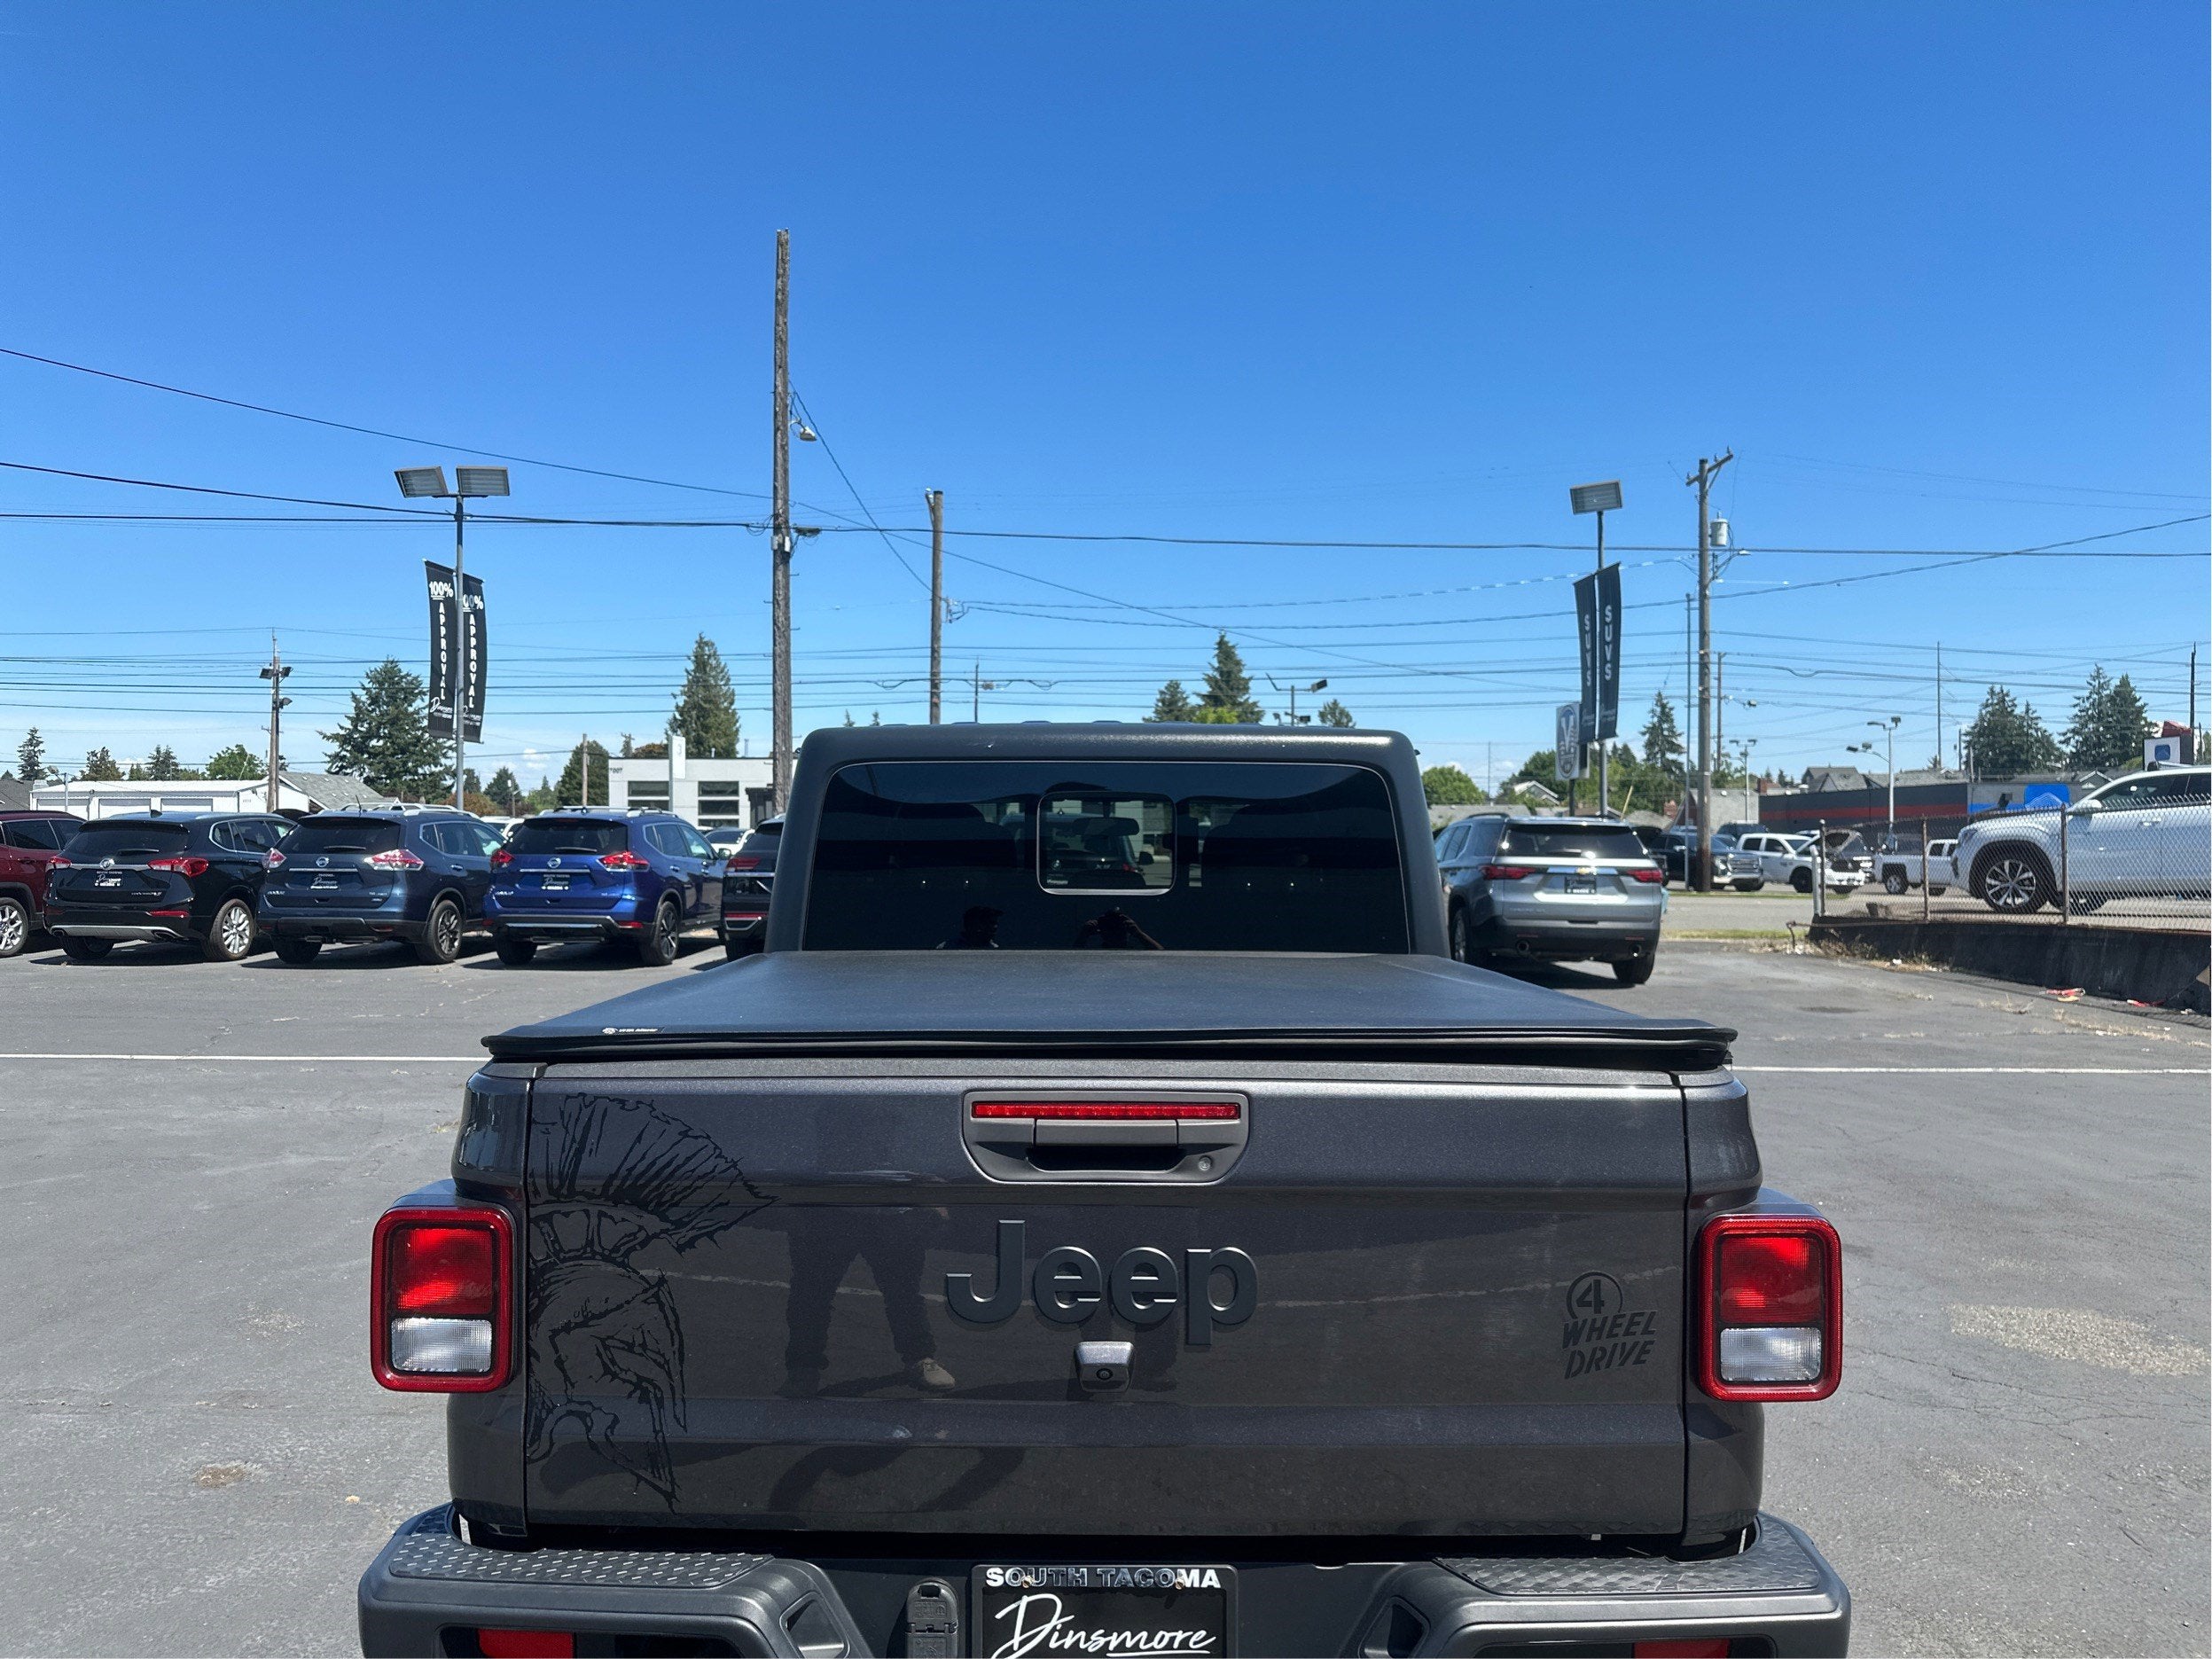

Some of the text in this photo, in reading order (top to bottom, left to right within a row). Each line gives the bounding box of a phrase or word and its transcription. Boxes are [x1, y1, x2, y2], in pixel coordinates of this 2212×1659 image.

[429, 581, 454, 599] 100%
[462, 594, 484, 610] 00%
[438, 601, 448, 700] APPROVAL
[468, 614, 478, 708] APPROVAL
[1583, 614, 1592, 687] SUVS
[1604, 604, 1613, 682] SUVS
[945, 1219, 1258, 1346] Jeep
[1575, 1279, 1606, 1315] 4
[1562, 1311, 1658, 1350] WHEEL
[1564, 1339, 1657, 1380] DRIVE
[985, 1567, 1222, 1588] SOUTH TACOMA
[991, 1593, 1216, 1659] Dinsmore
